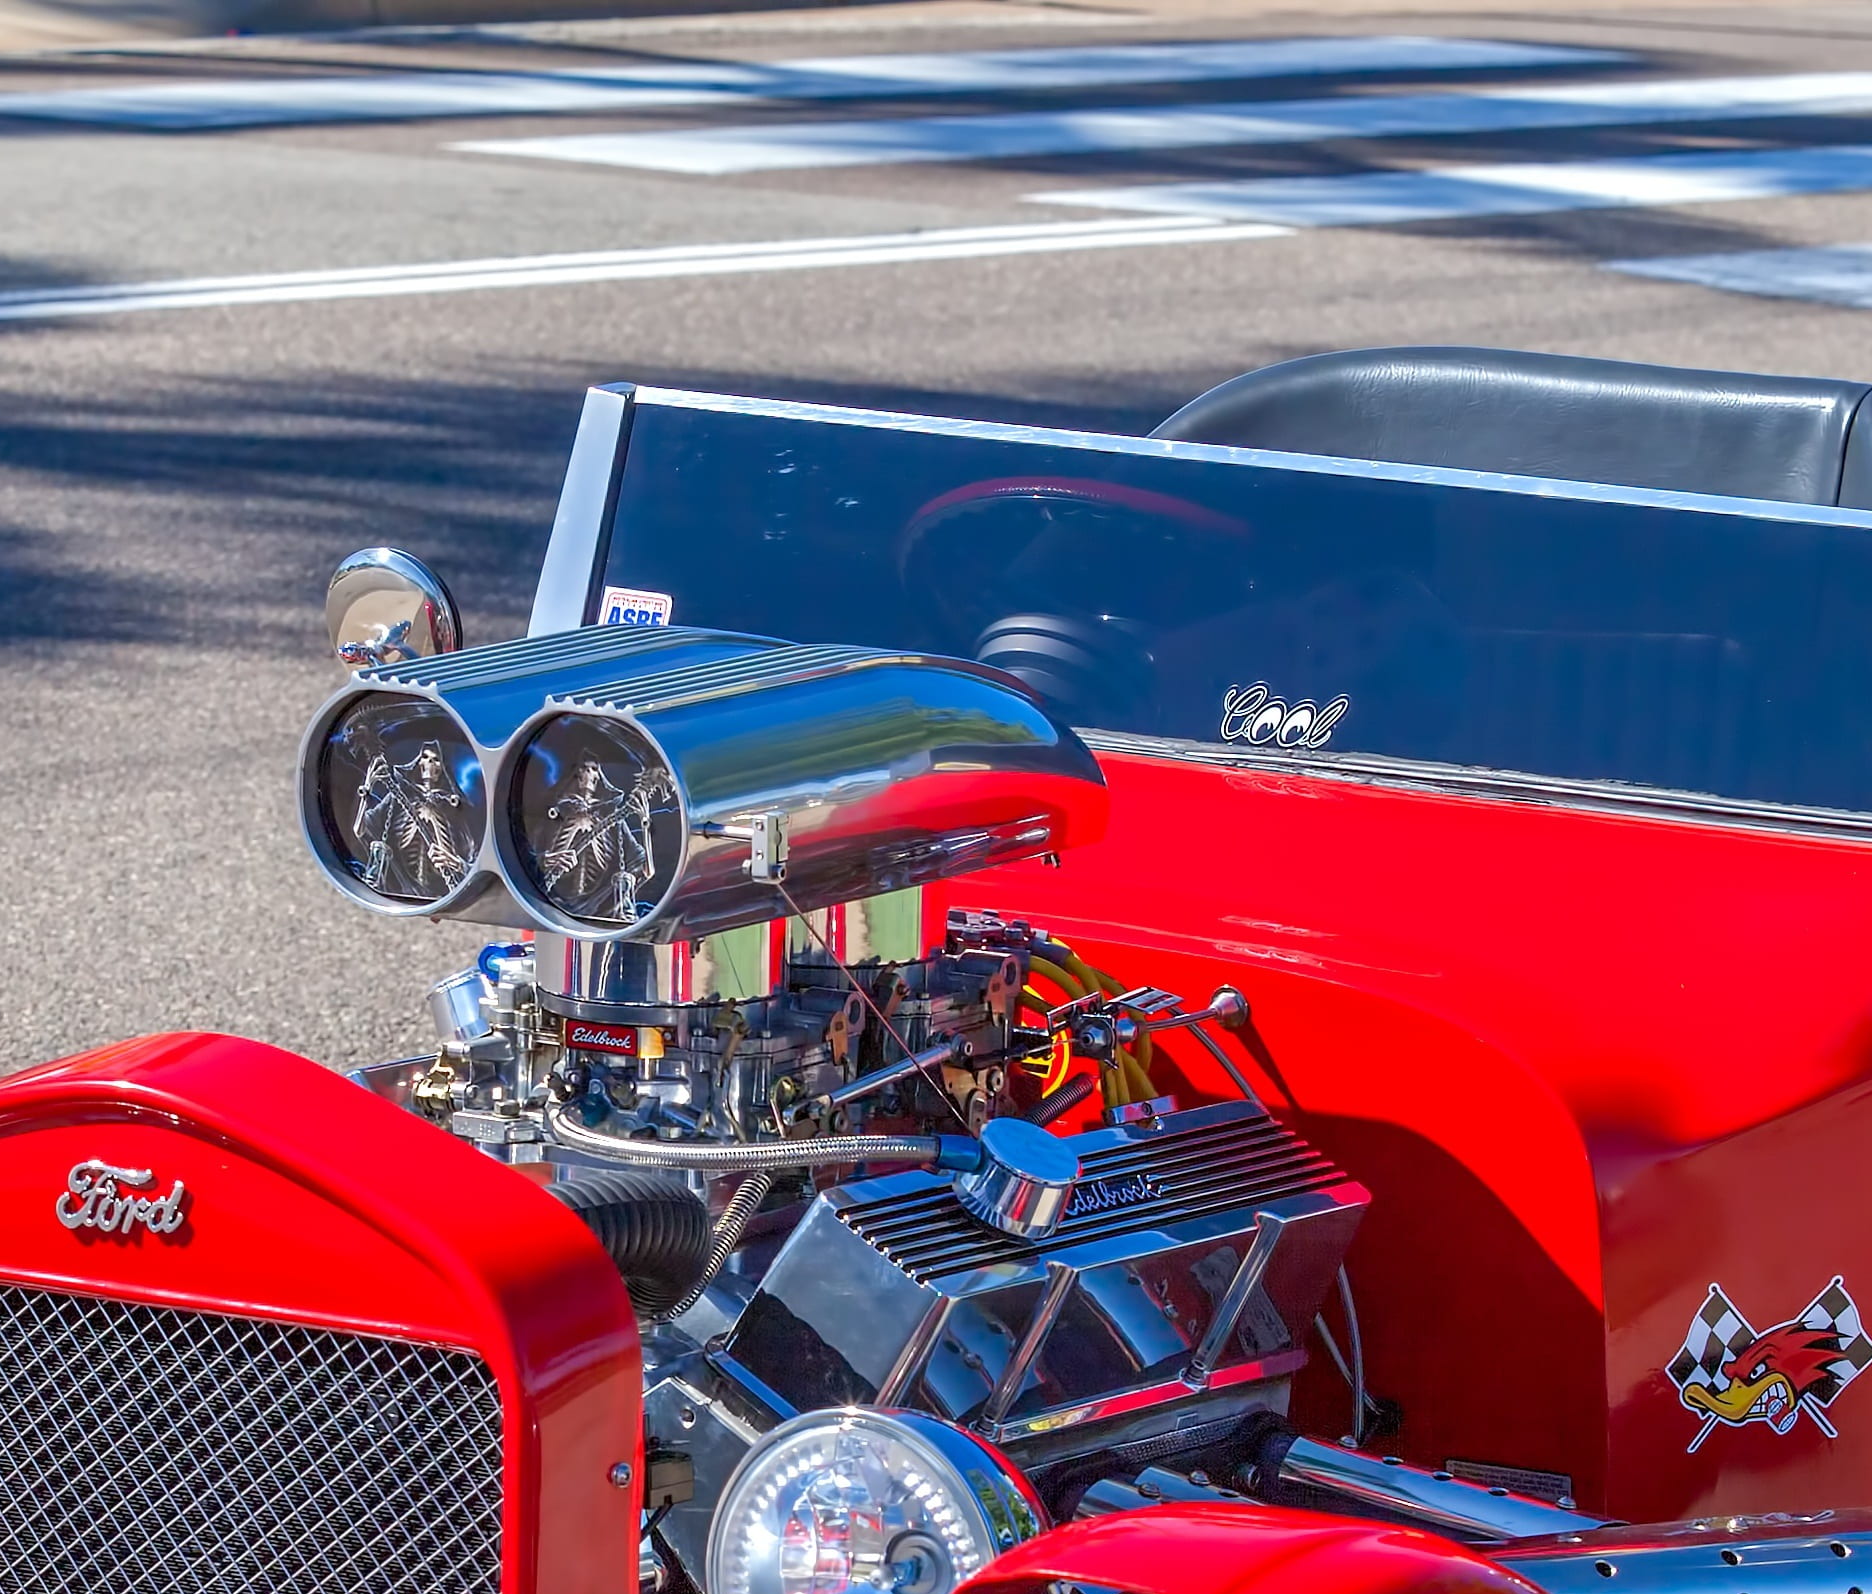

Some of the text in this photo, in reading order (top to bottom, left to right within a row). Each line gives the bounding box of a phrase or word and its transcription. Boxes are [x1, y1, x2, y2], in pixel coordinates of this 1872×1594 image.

[1220, 682, 1350, 749] Cool
[572, 1026, 631, 1049] Edelbrock
[56, 1159, 184, 1234] Ford
[1065, 1174, 1161, 1216] delbrock
